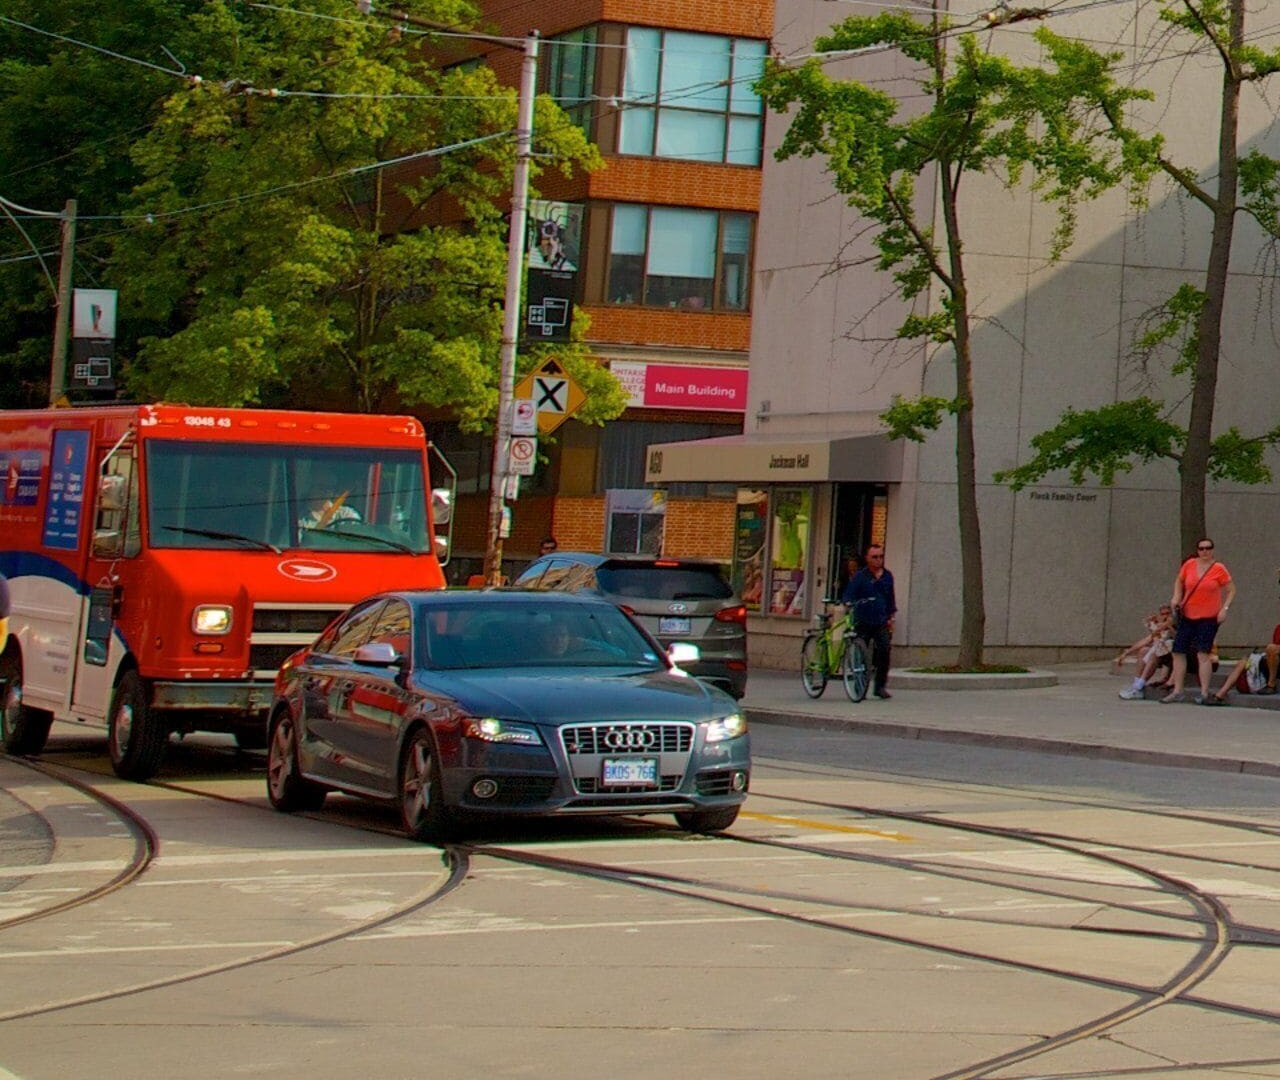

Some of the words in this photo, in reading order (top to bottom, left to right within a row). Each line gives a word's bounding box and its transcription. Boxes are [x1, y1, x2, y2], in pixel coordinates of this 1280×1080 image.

[655, 383, 684, 394] Main
[687, 384, 736, 399] Building
[797, 454, 809, 469] Hall
